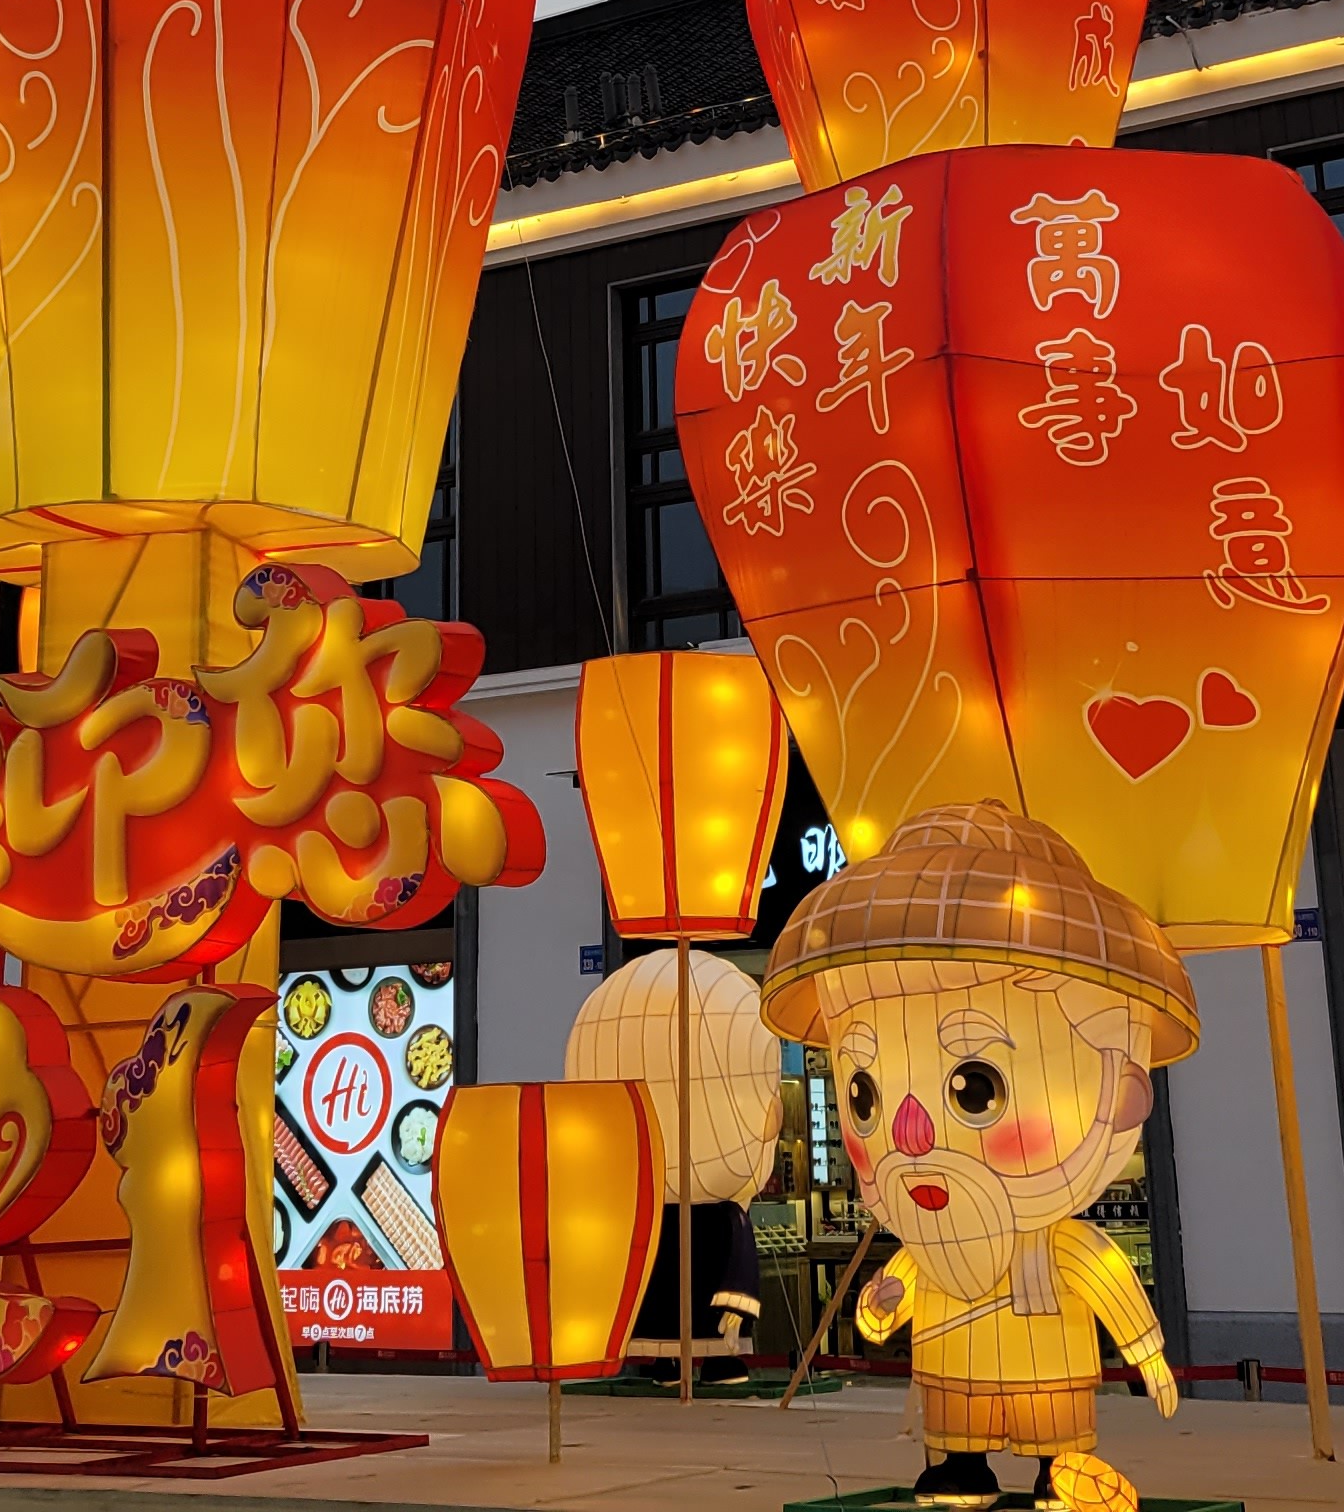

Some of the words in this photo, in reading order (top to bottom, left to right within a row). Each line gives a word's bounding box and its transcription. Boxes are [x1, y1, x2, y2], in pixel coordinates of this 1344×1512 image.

[703, 279, 817, 537] 快樂
[809, 183, 915, 434] 新年
[1010, 189, 1138, 466] 萬事
[1160, 324, 1331, 614] 如意
[321, 1055, 373, 1129] Hi
[356, 1285, 424, 1315] 海底捞
